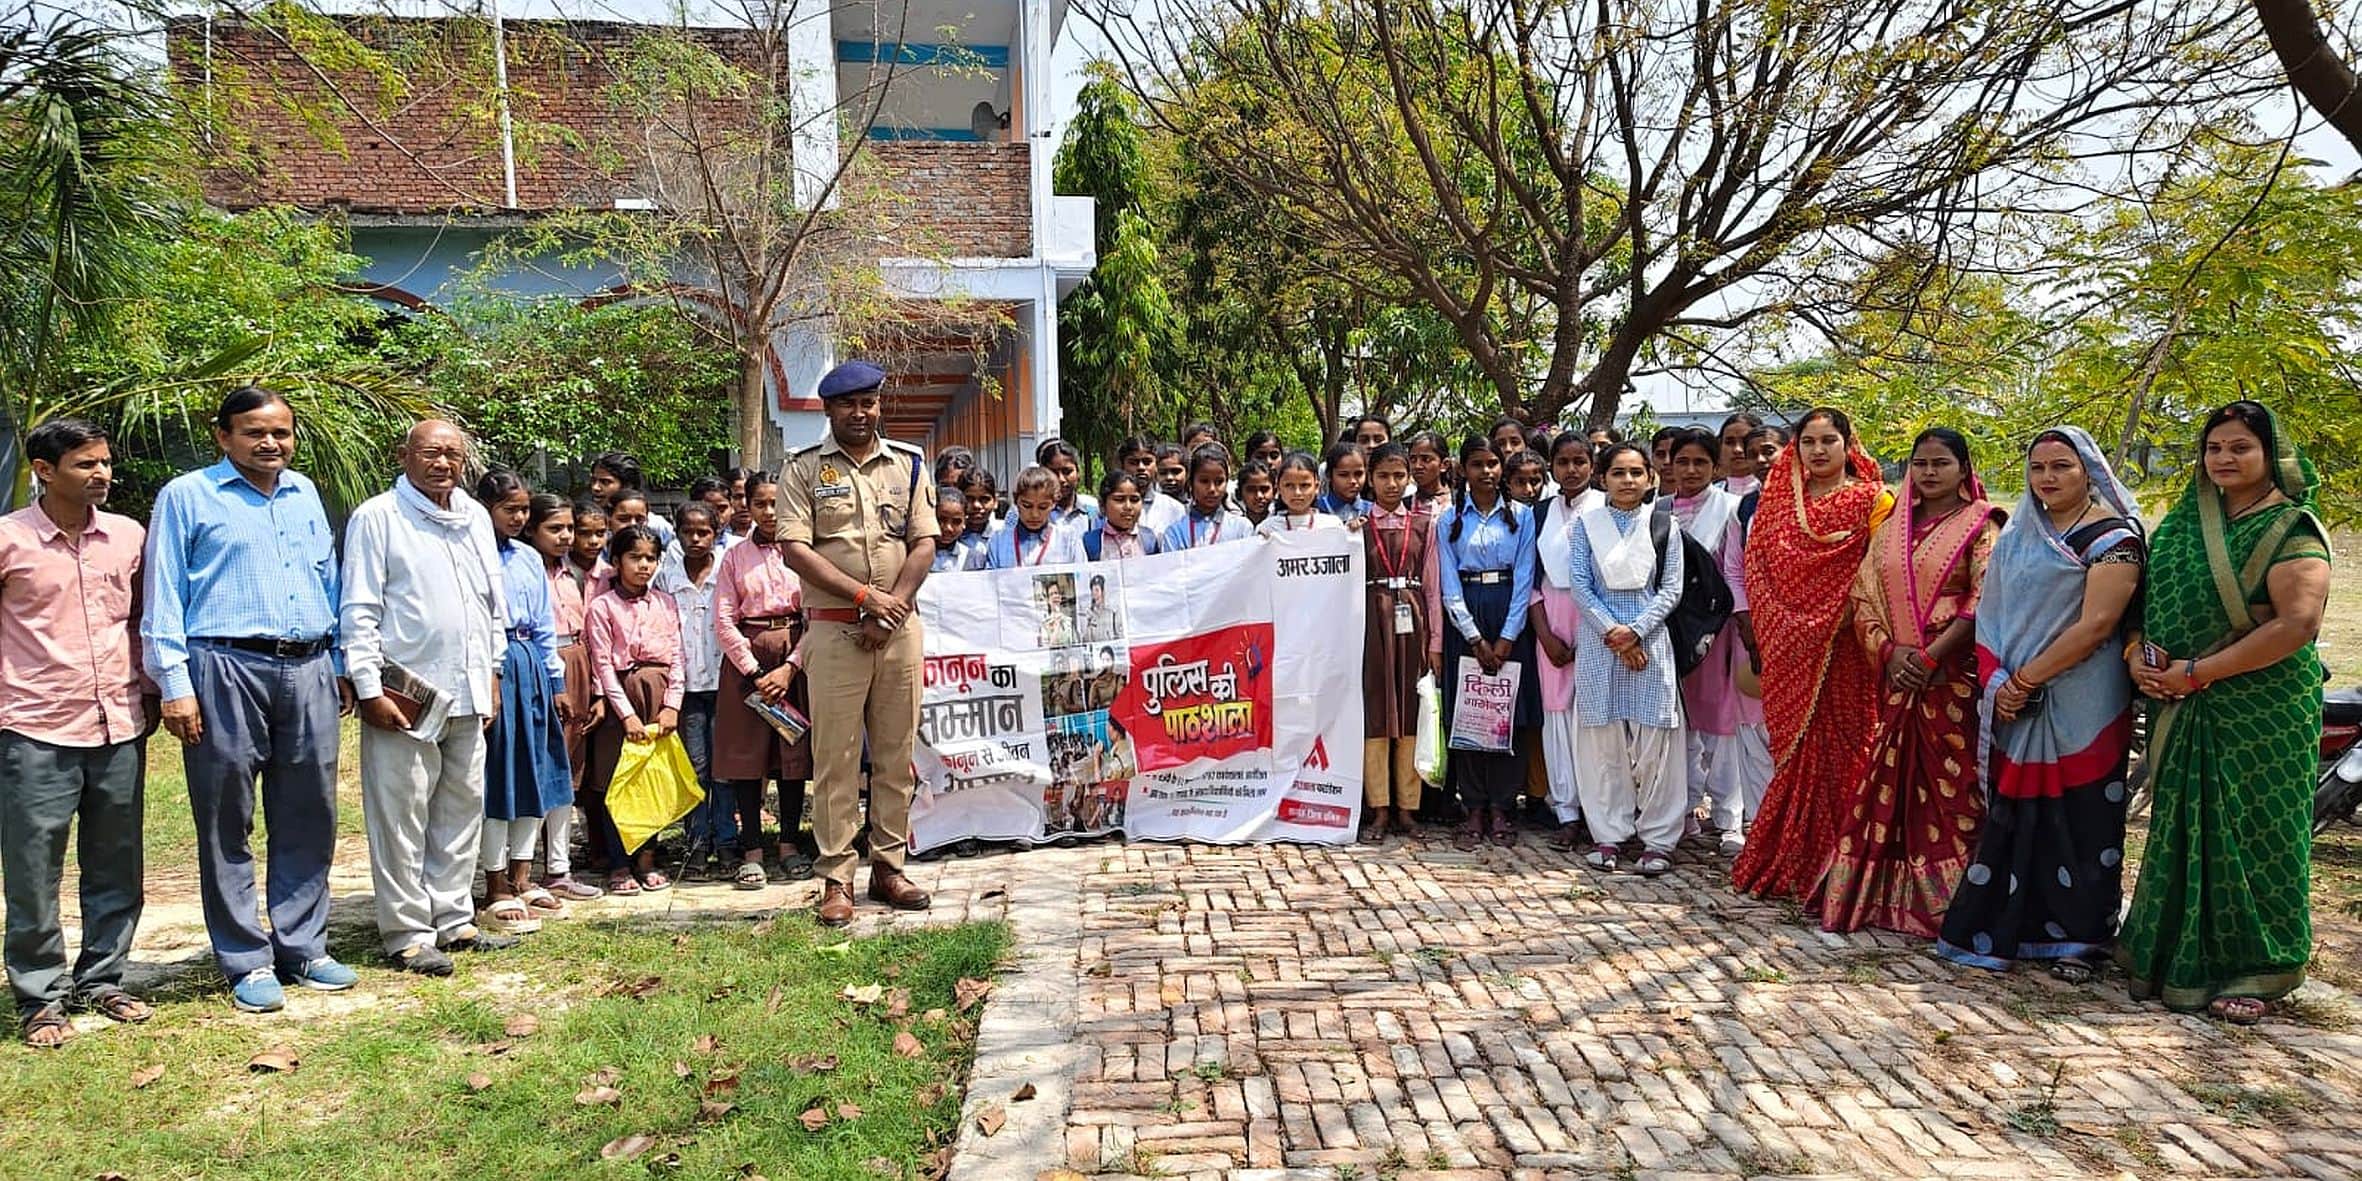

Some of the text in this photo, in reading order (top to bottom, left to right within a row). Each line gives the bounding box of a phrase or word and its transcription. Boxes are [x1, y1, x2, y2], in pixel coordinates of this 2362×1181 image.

[1277, 554, 1350, 577] अमर उजाला
[990, 664, 1017, 689] का
[1142, 653, 1237, 715] पुलिस की
[1463, 673, 1512, 698] दिल्ली
[1163, 701, 1254, 743] पाठशाला
